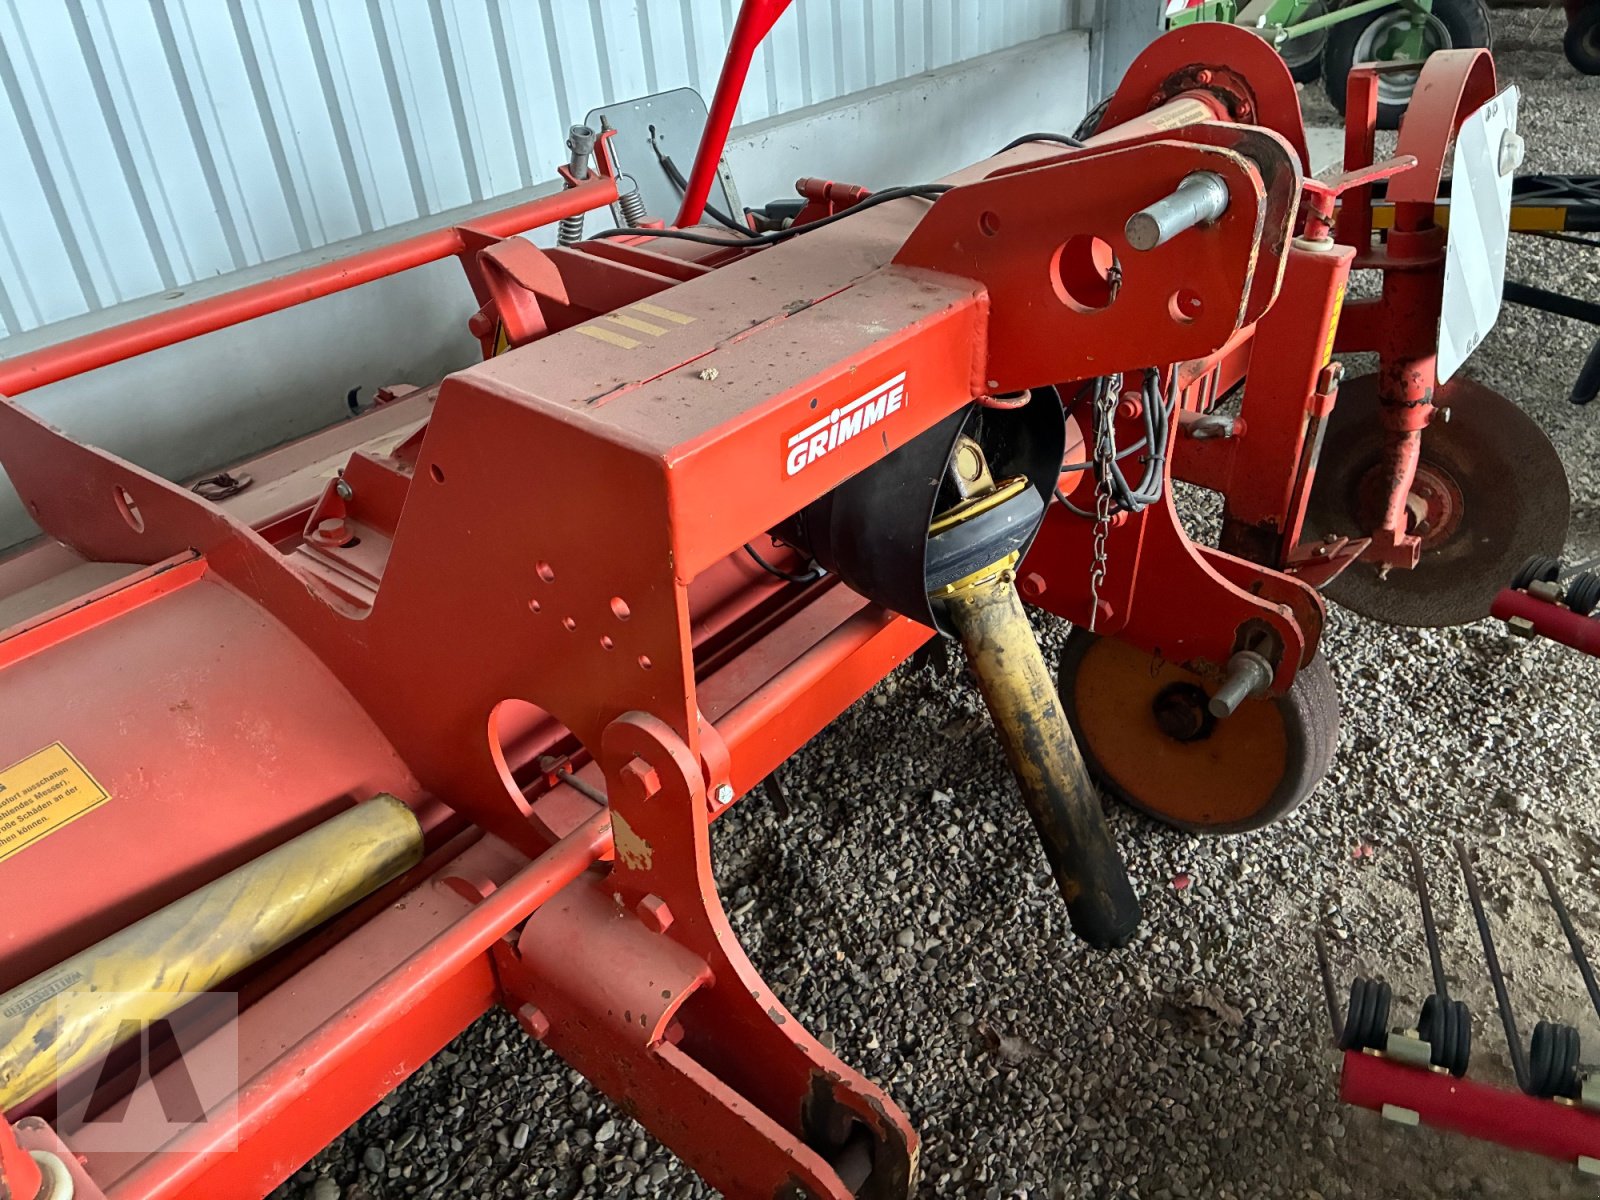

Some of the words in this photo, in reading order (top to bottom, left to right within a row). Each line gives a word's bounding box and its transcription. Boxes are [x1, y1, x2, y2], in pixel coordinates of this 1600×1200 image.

[786, 383, 905, 476] GRIMME
[22, 766, 69, 796] ausschalten
[34, 779, 71, 800] Messer).
[16, 800, 53, 823] Schäden
[53, 794, 64, 803] an
[64, 785, 79, 797] der
